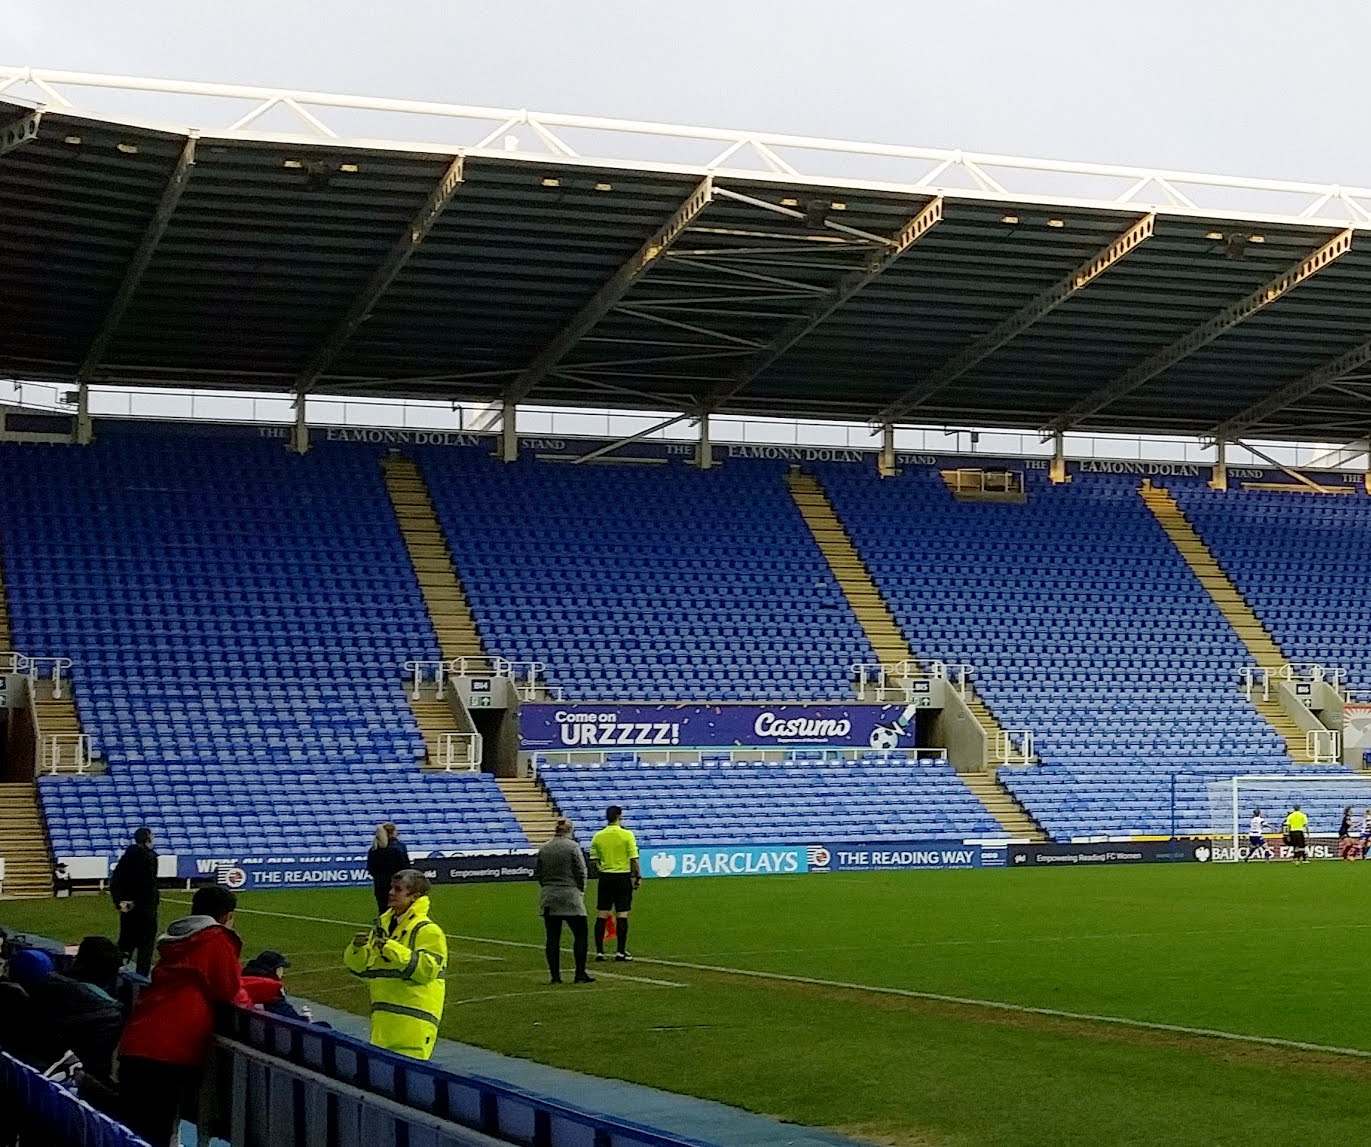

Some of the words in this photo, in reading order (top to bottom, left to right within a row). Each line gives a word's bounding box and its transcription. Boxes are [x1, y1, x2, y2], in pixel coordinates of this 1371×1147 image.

[258, 428, 286, 439] THE
[326, 428, 411, 445] EAMONN
[415, 431, 480, 447] DOLAN
[521, 438, 565, 450] STAND
[666, 444, 692, 455] THE
[728, 445, 801, 460] EAMONN
[806, 449, 863, 463] DOLAN
[897, 455, 936, 465] STAND
[1024, 460, 1047, 470] THE
[1079, 460, 1145, 474] EAMONN
[1150, 463, 1199, 476] DOLAN
[1228, 469, 1263, 479] STAND
[1341, 474, 1363, 483] THE
[555, 711, 597, 723] Come
[598, 713, 616, 723] on
[754, 712, 851, 737] Casumo
[561, 723, 680, 745] URZZZZ!
[682, 851, 798, 875] BARCLAYS
[837, 851, 869, 864] THE
[872, 851, 939, 865] READING
[941, 850, 975, 864] WAY
[1036, 854, 1078, 863] Empowering
[1078, 853, 1105, 862] Reading
[1117, 852, 1142, 860] Women
[252, 871, 281, 883] THE
[284, 870, 348, 882] READING
[350, 869, 374, 881] WA
[450, 868, 500, 878] Empowering
[501, 866, 535, 877] Reading
